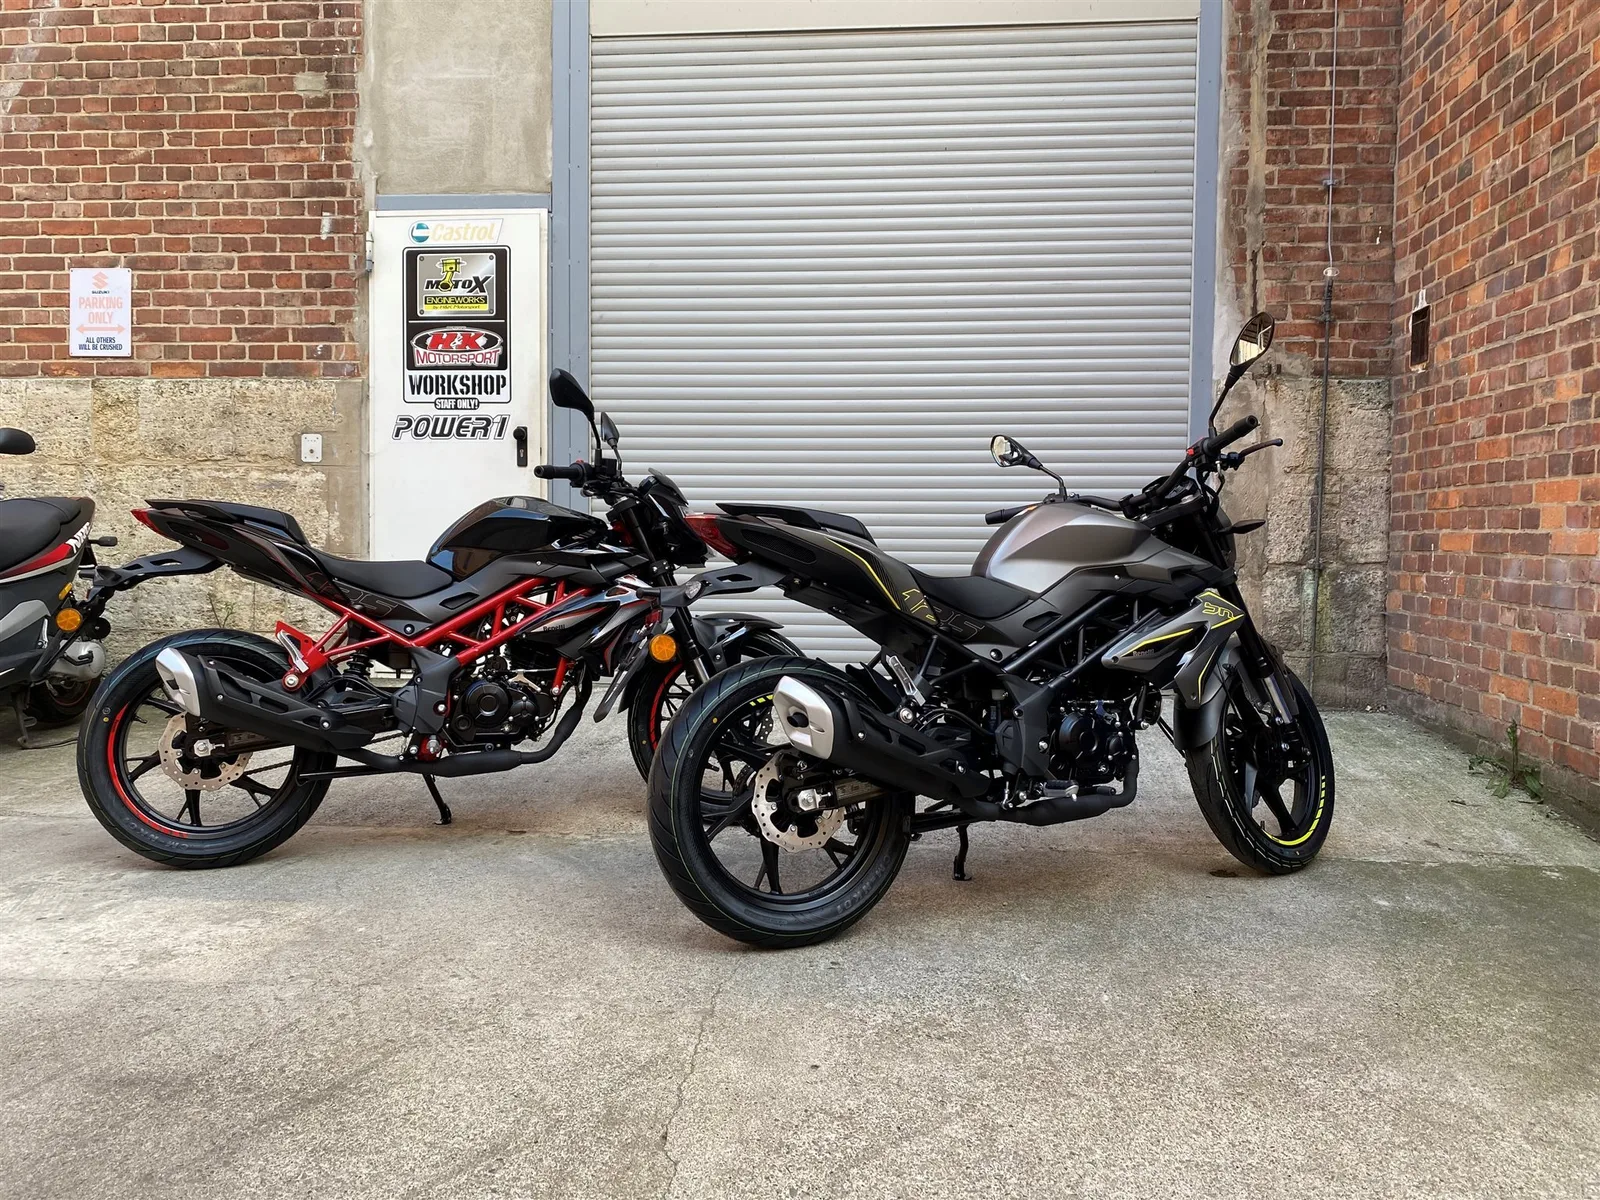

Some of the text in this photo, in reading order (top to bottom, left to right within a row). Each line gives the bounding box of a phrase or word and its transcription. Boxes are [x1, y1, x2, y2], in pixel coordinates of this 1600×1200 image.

[431, 222, 496, 242] Castrol
[78, 296, 123, 309] PARKING
[426, 296, 486, 304] ENGINEWORKS
[88, 311, 114, 324] ONLY
[427, 331, 485, 350] H&K
[415, 349, 500, 365] MOTORSPORT
[408, 374, 507, 395] WORKSHOP
[435, 399, 479, 409] STAFF ONLY!
[393, 415, 510, 439] POWER1
[542, 624, 566, 632] Benelli
